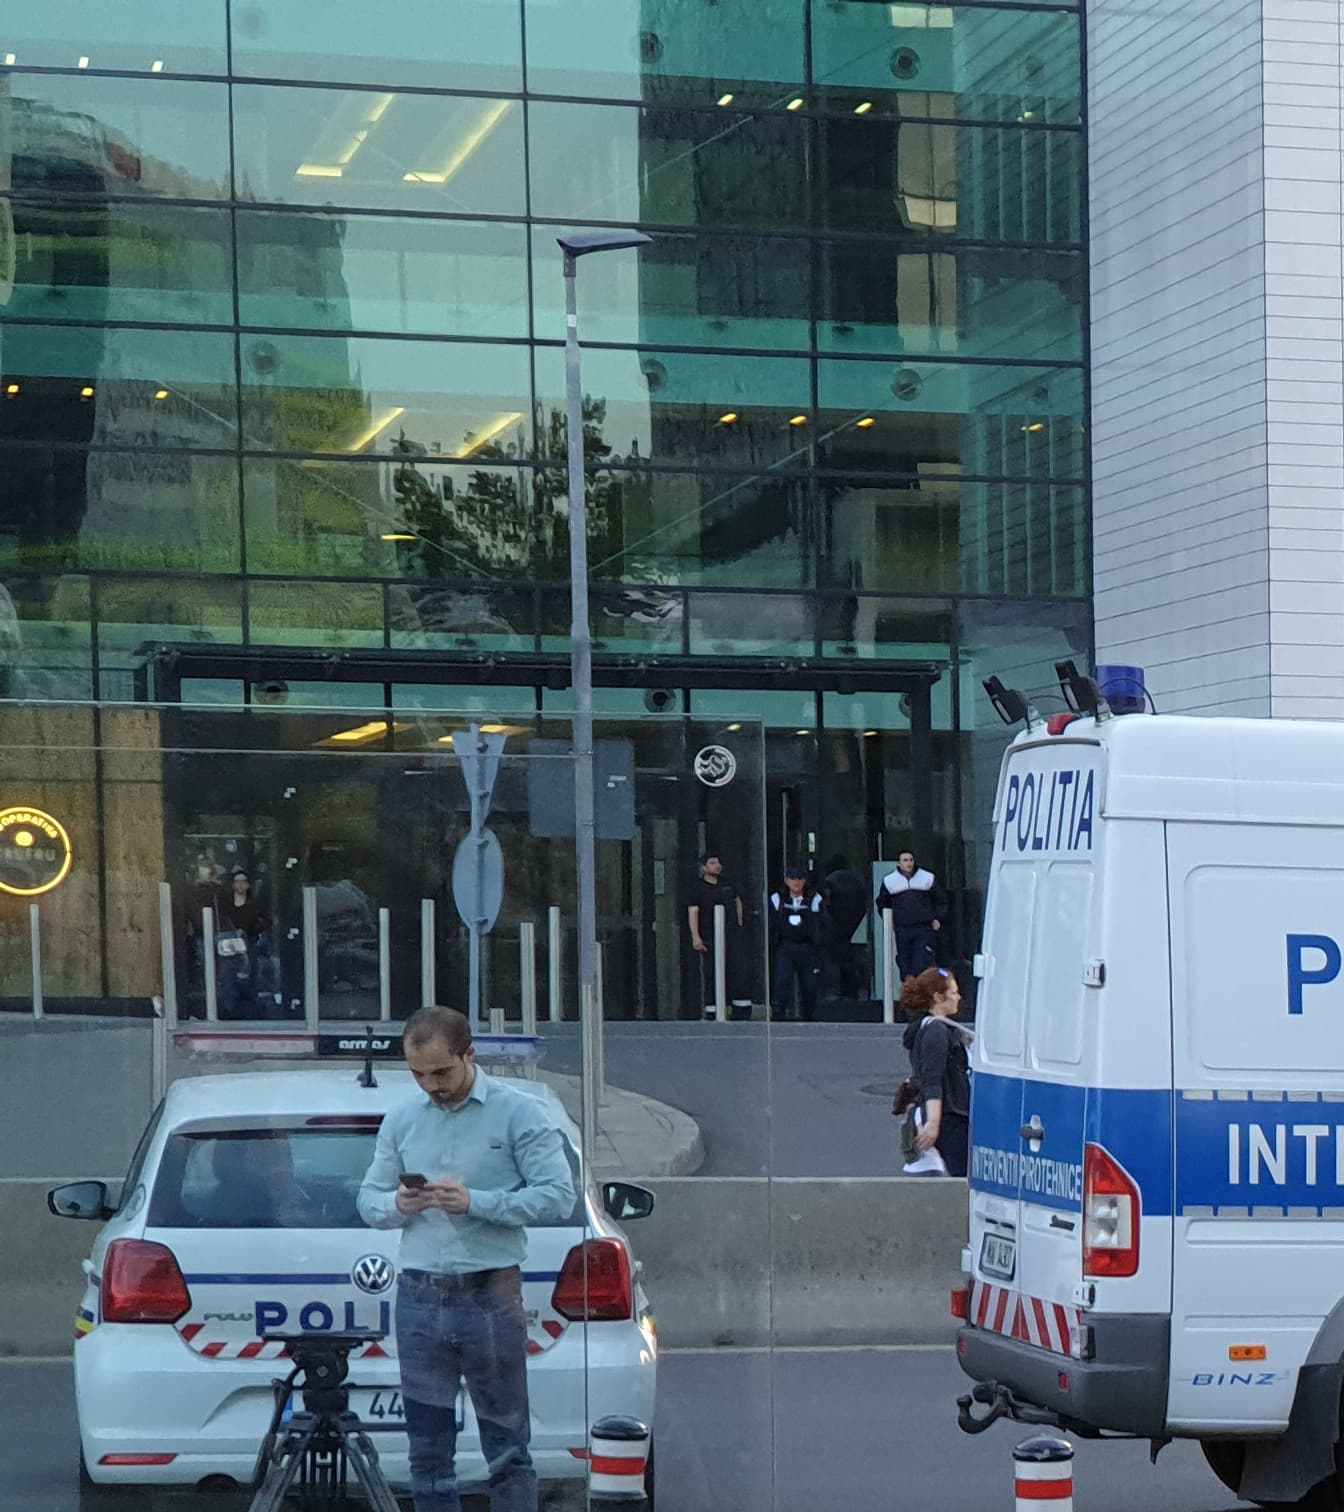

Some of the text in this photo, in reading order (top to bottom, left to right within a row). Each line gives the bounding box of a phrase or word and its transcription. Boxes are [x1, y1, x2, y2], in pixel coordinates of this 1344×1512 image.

[1002, 769, 1094, 852] POLITIA
[1019, 1153, 1082, 1201] PIROTEHNICE
[1192, 1373, 1276, 1386] BINZ
